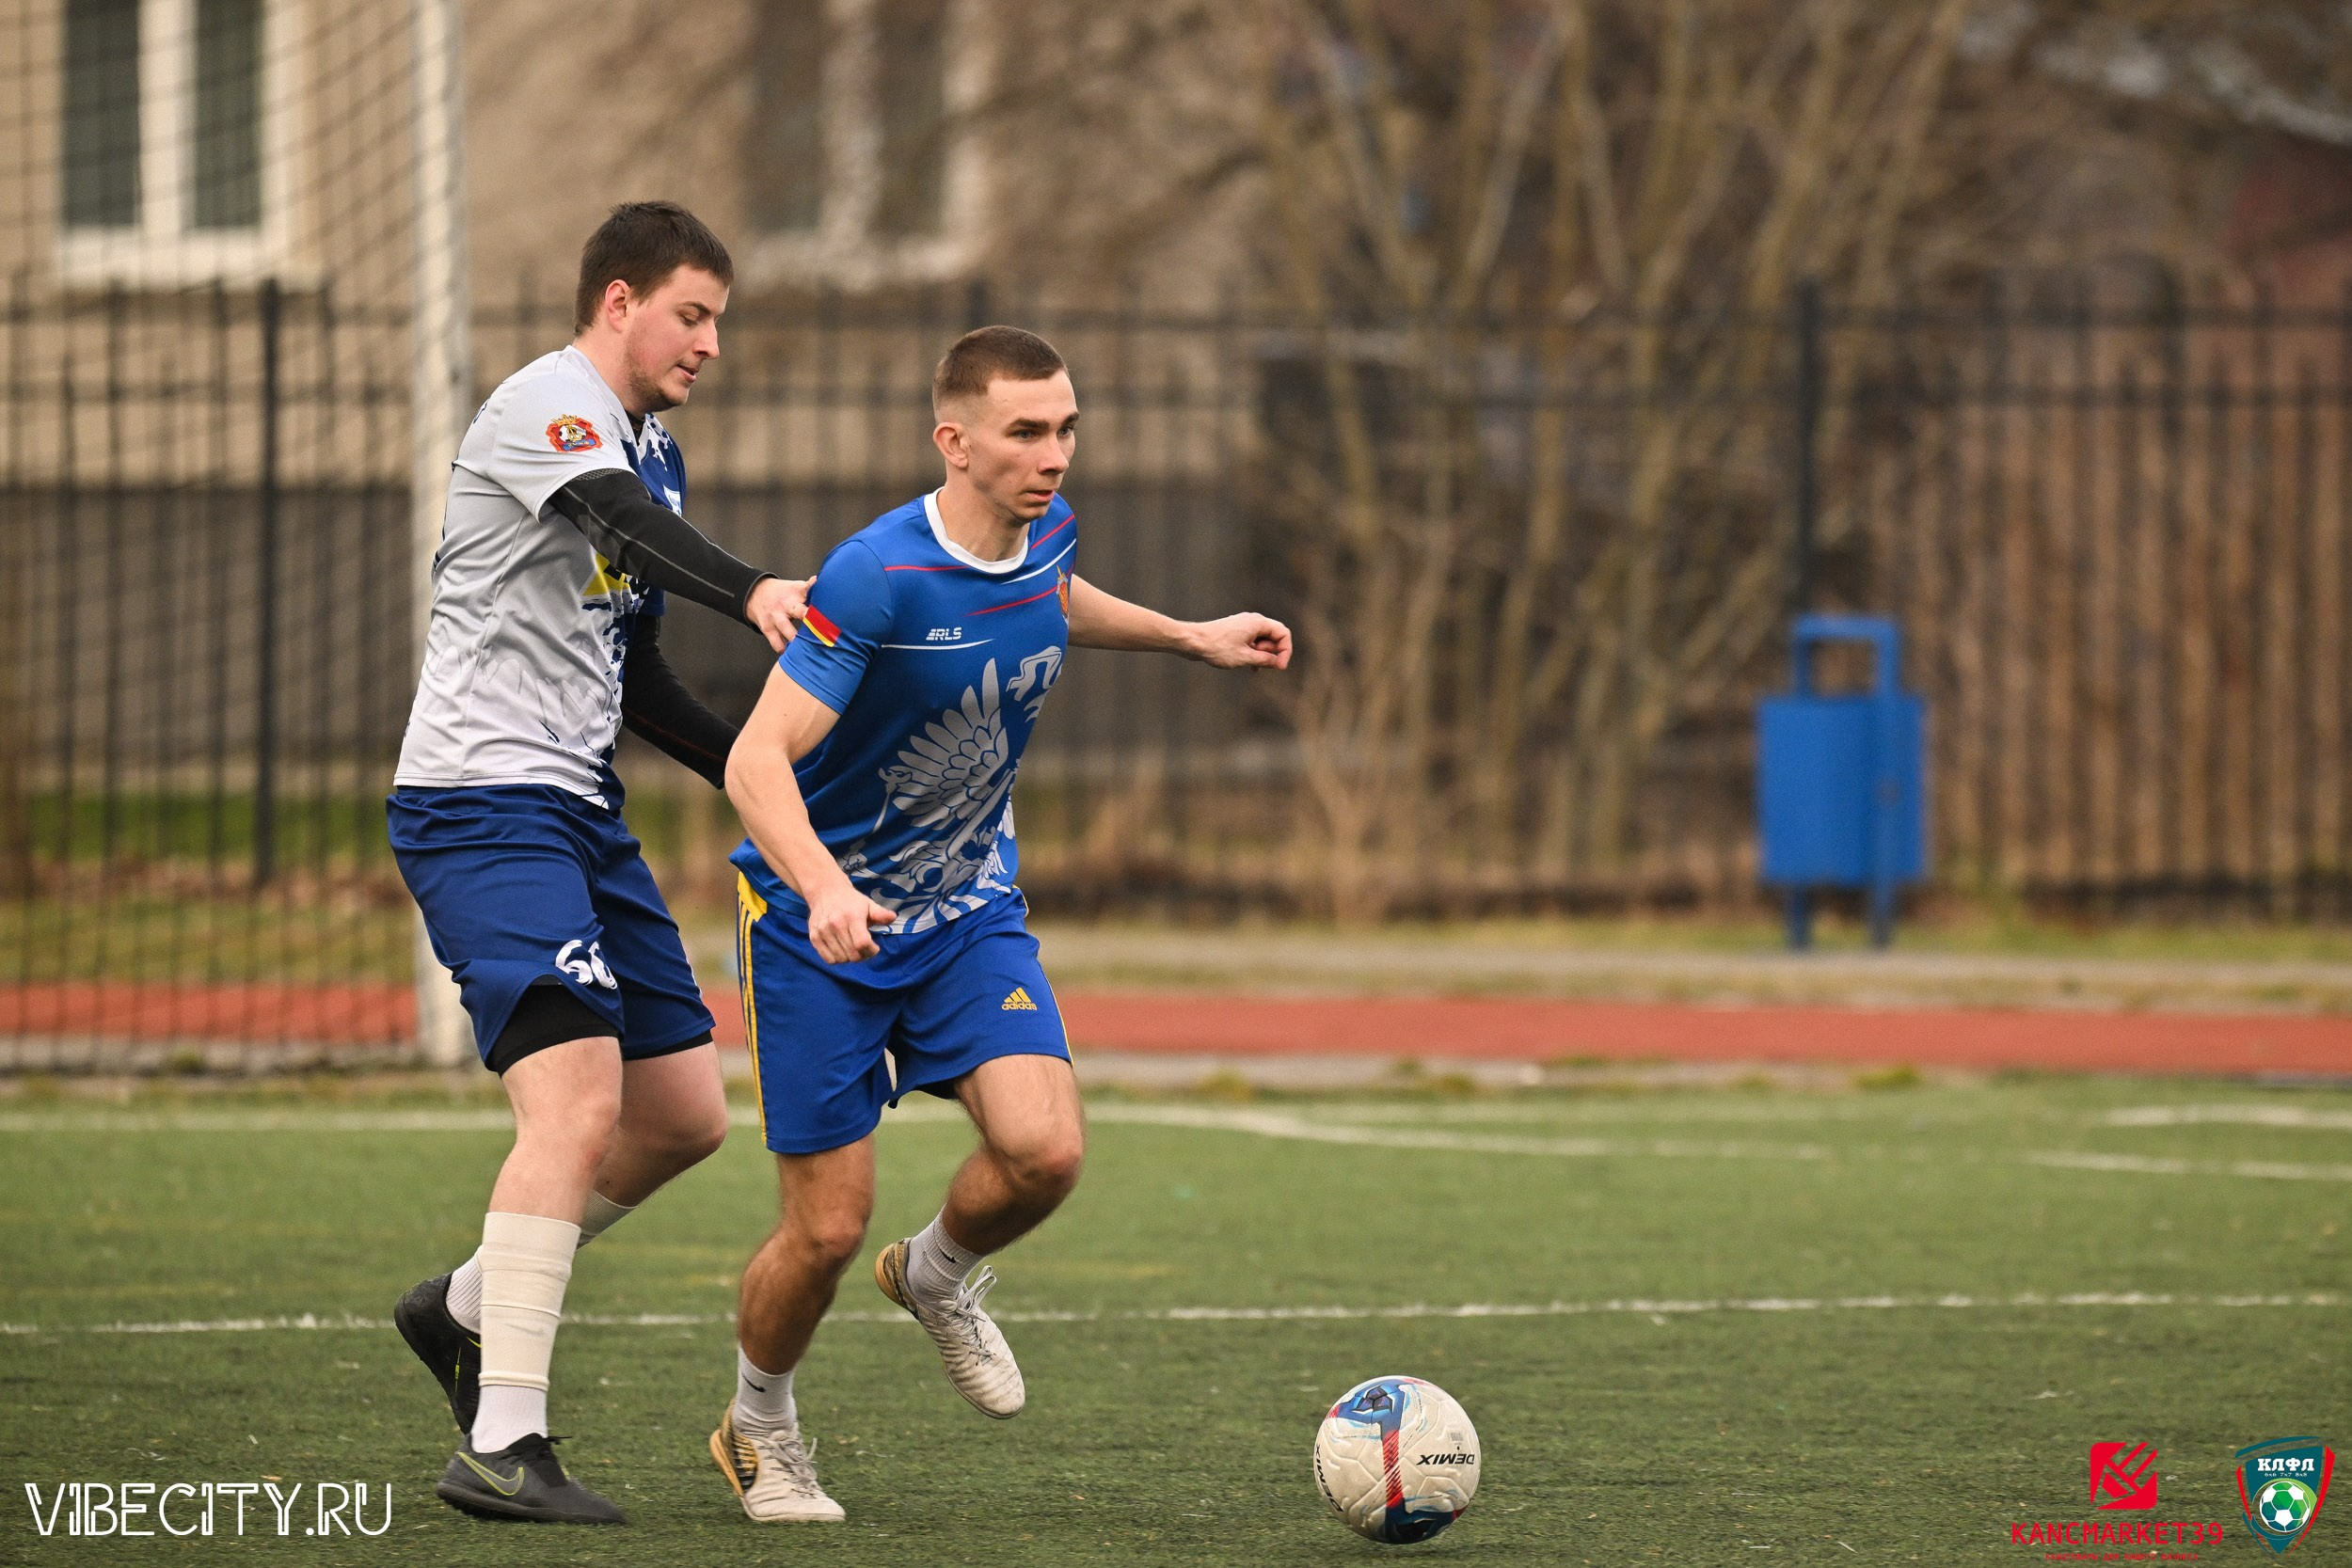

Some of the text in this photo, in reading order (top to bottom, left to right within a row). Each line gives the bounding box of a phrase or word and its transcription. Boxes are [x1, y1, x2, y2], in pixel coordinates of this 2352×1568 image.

[1001, 1002, 1038, 1011] adidas
[1416, 1453, 1474, 1465] DEMIX
[1316, 1444, 1343, 1513] DEMIX
